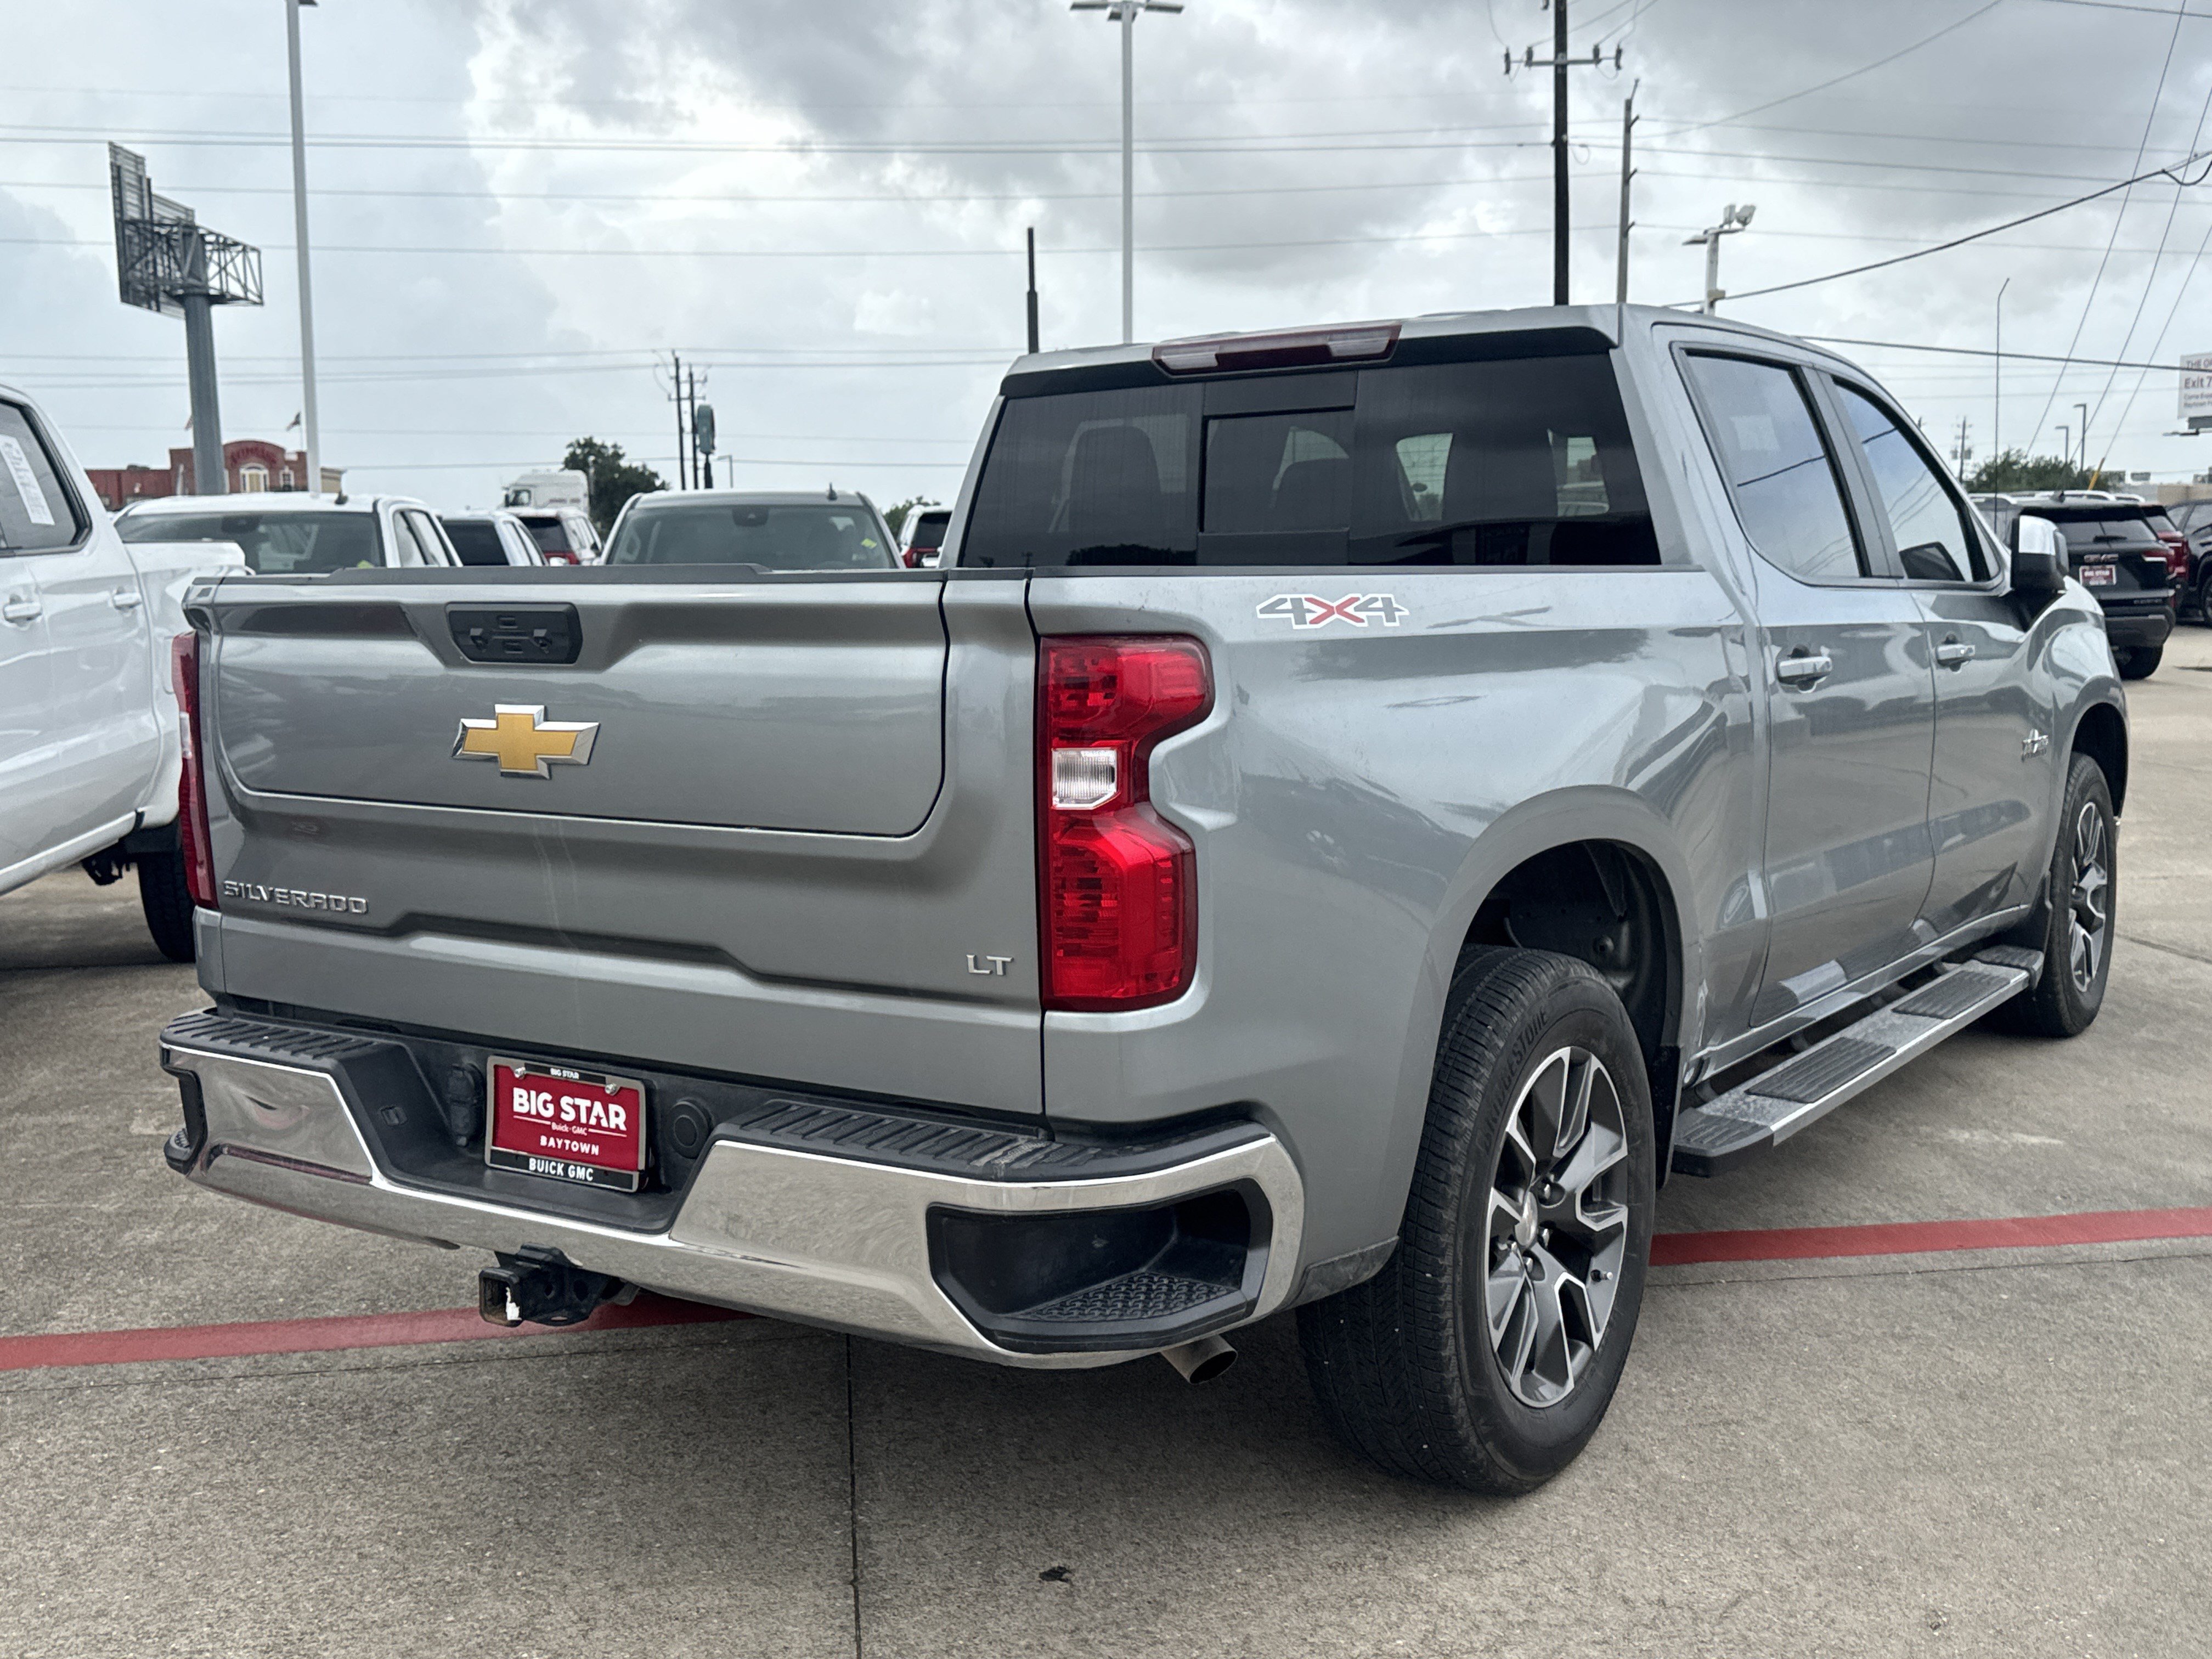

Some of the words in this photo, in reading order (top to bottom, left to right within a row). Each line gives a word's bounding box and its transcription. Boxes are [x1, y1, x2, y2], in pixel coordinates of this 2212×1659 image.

[2185, 376, 2203, 389] Exit
[224, 880, 368, 913] SILVERADO
[966, 954, 1014, 975] LT
[550, 1067, 561, 1077] BIG
[562, 1070, 579, 1080] STAR
[513, 1087, 554, 1118] BIG
[560, 1095, 627, 1131] STAR
[540, 1135, 600, 1156] BAYTOWN
[529, 1157, 565, 1176] BUICK
[568, 1165, 594, 1181] GMC
